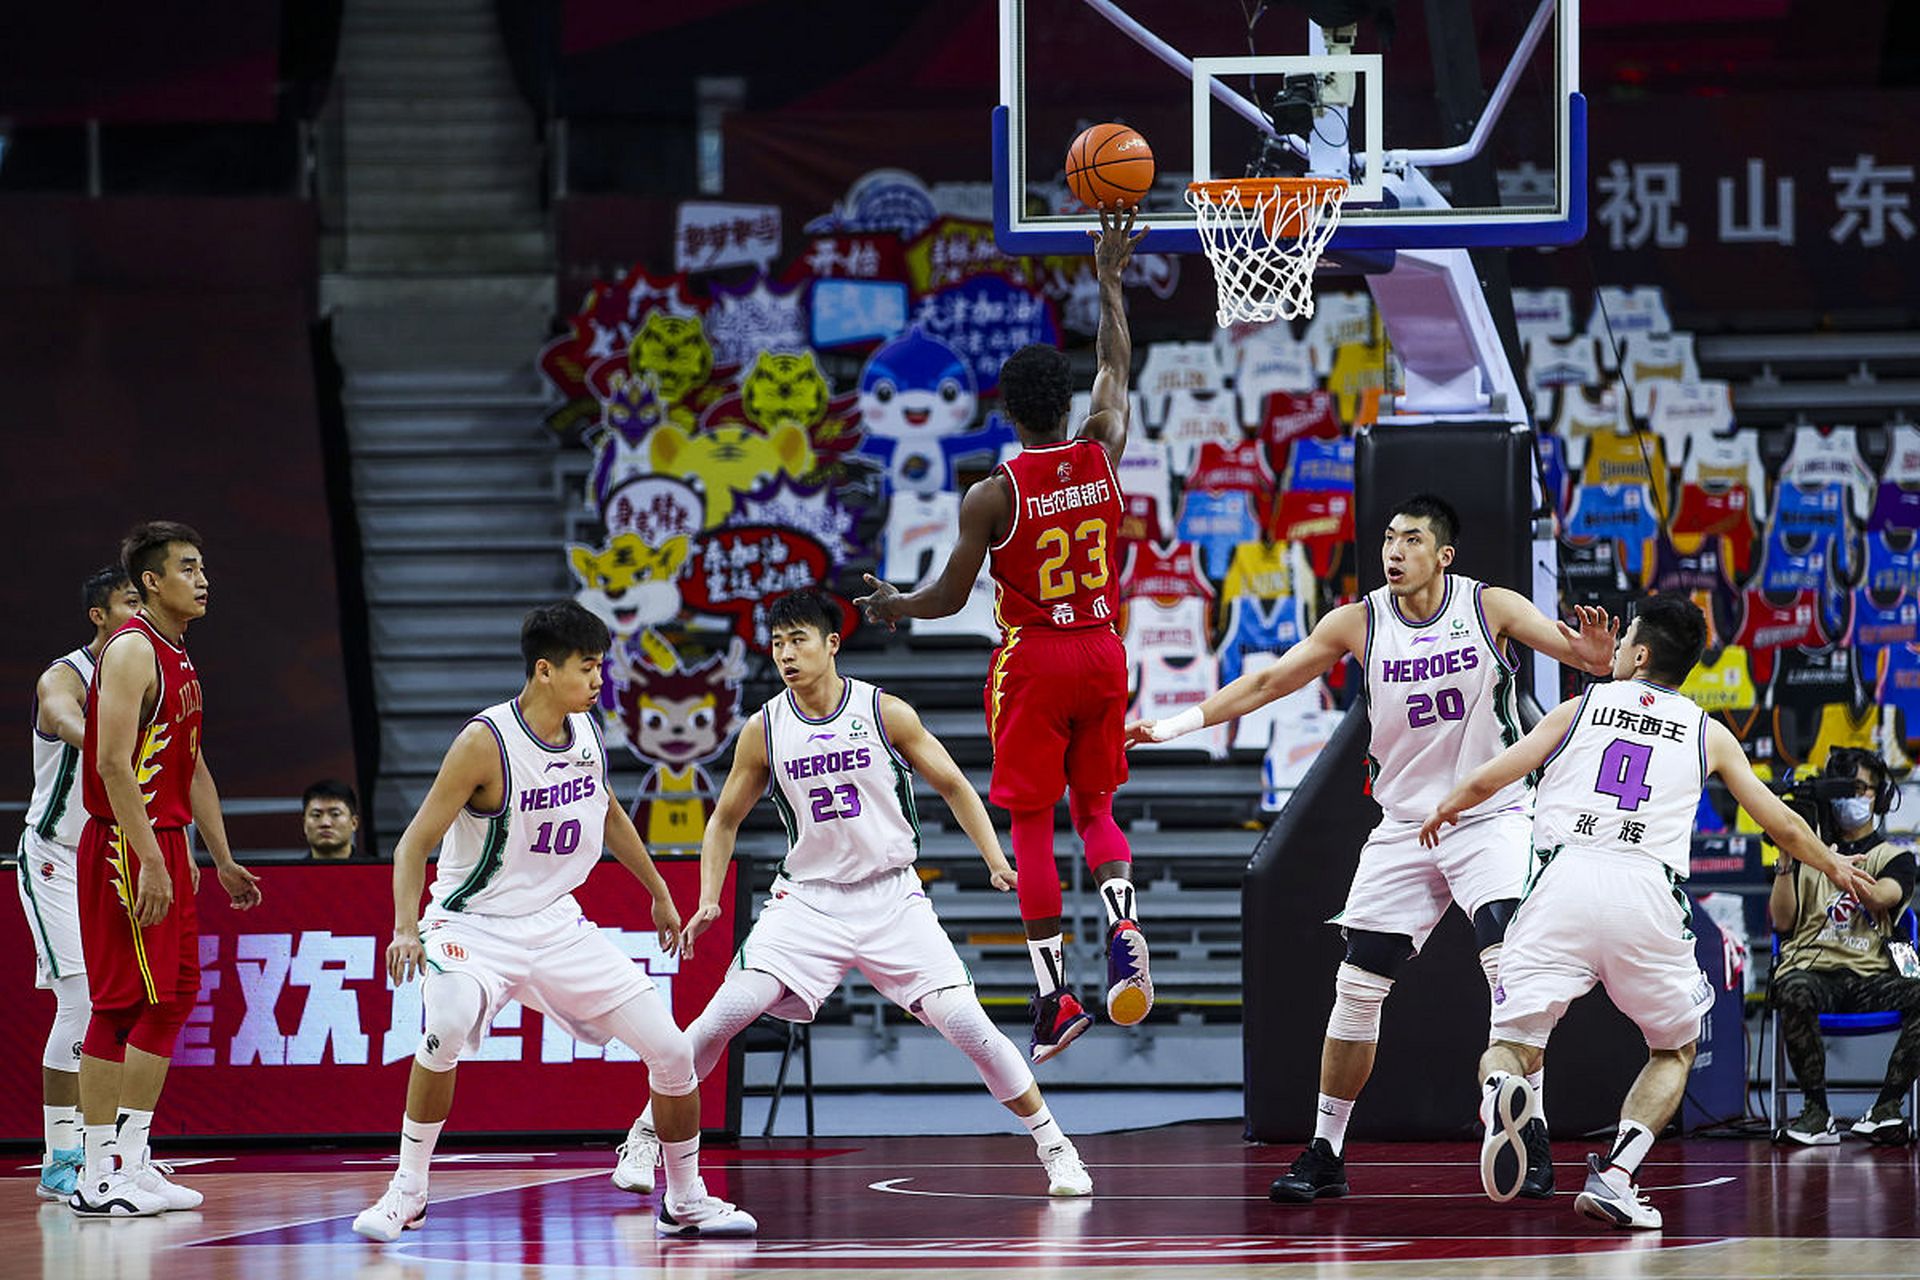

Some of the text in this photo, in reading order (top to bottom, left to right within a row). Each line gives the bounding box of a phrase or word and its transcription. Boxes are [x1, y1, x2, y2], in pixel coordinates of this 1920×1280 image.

[1036, 518, 1109, 601] 23
[1382, 646, 1479, 682] HEROES
[1406, 687, 1465, 728] 20
[1591, 706, 1687, 743] 山东西王
[784, 747, 871, 780] HEROES
[1594, 738, 1654, 812] 4
[520, 775, 596, 812] HEROES
[809, 783, 861, 823] 23
[529, 819, 582, 855] 10
